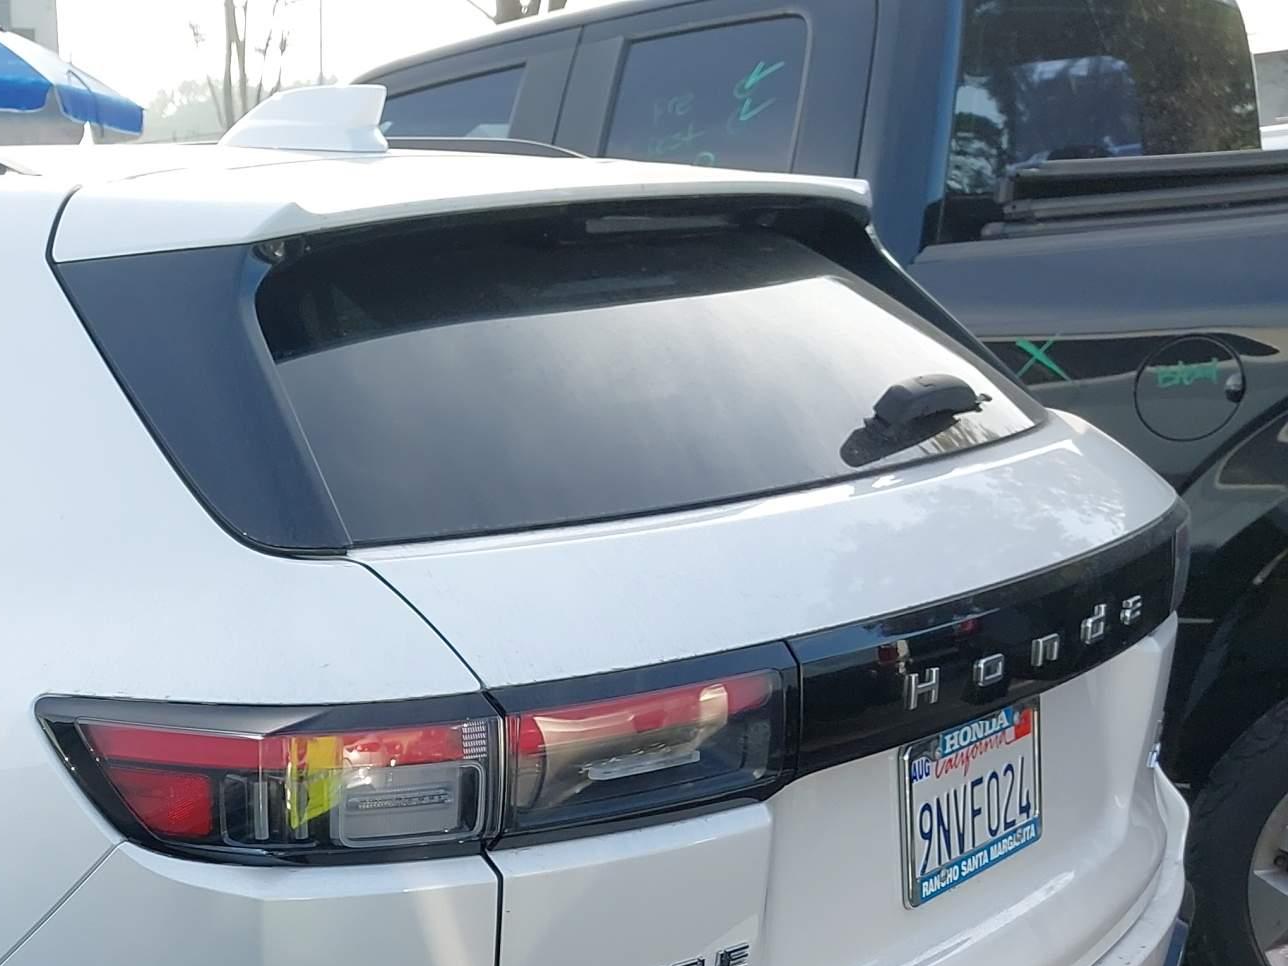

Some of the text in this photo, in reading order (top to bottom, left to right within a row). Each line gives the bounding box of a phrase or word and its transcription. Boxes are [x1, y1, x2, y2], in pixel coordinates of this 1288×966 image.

[912, 759, 931, 783] AUG
[918, 755, 1032, 876] 9NVF024
[961, 850, 989, 877] SANTA
[990, 823, 1036, 860] MARGITA
